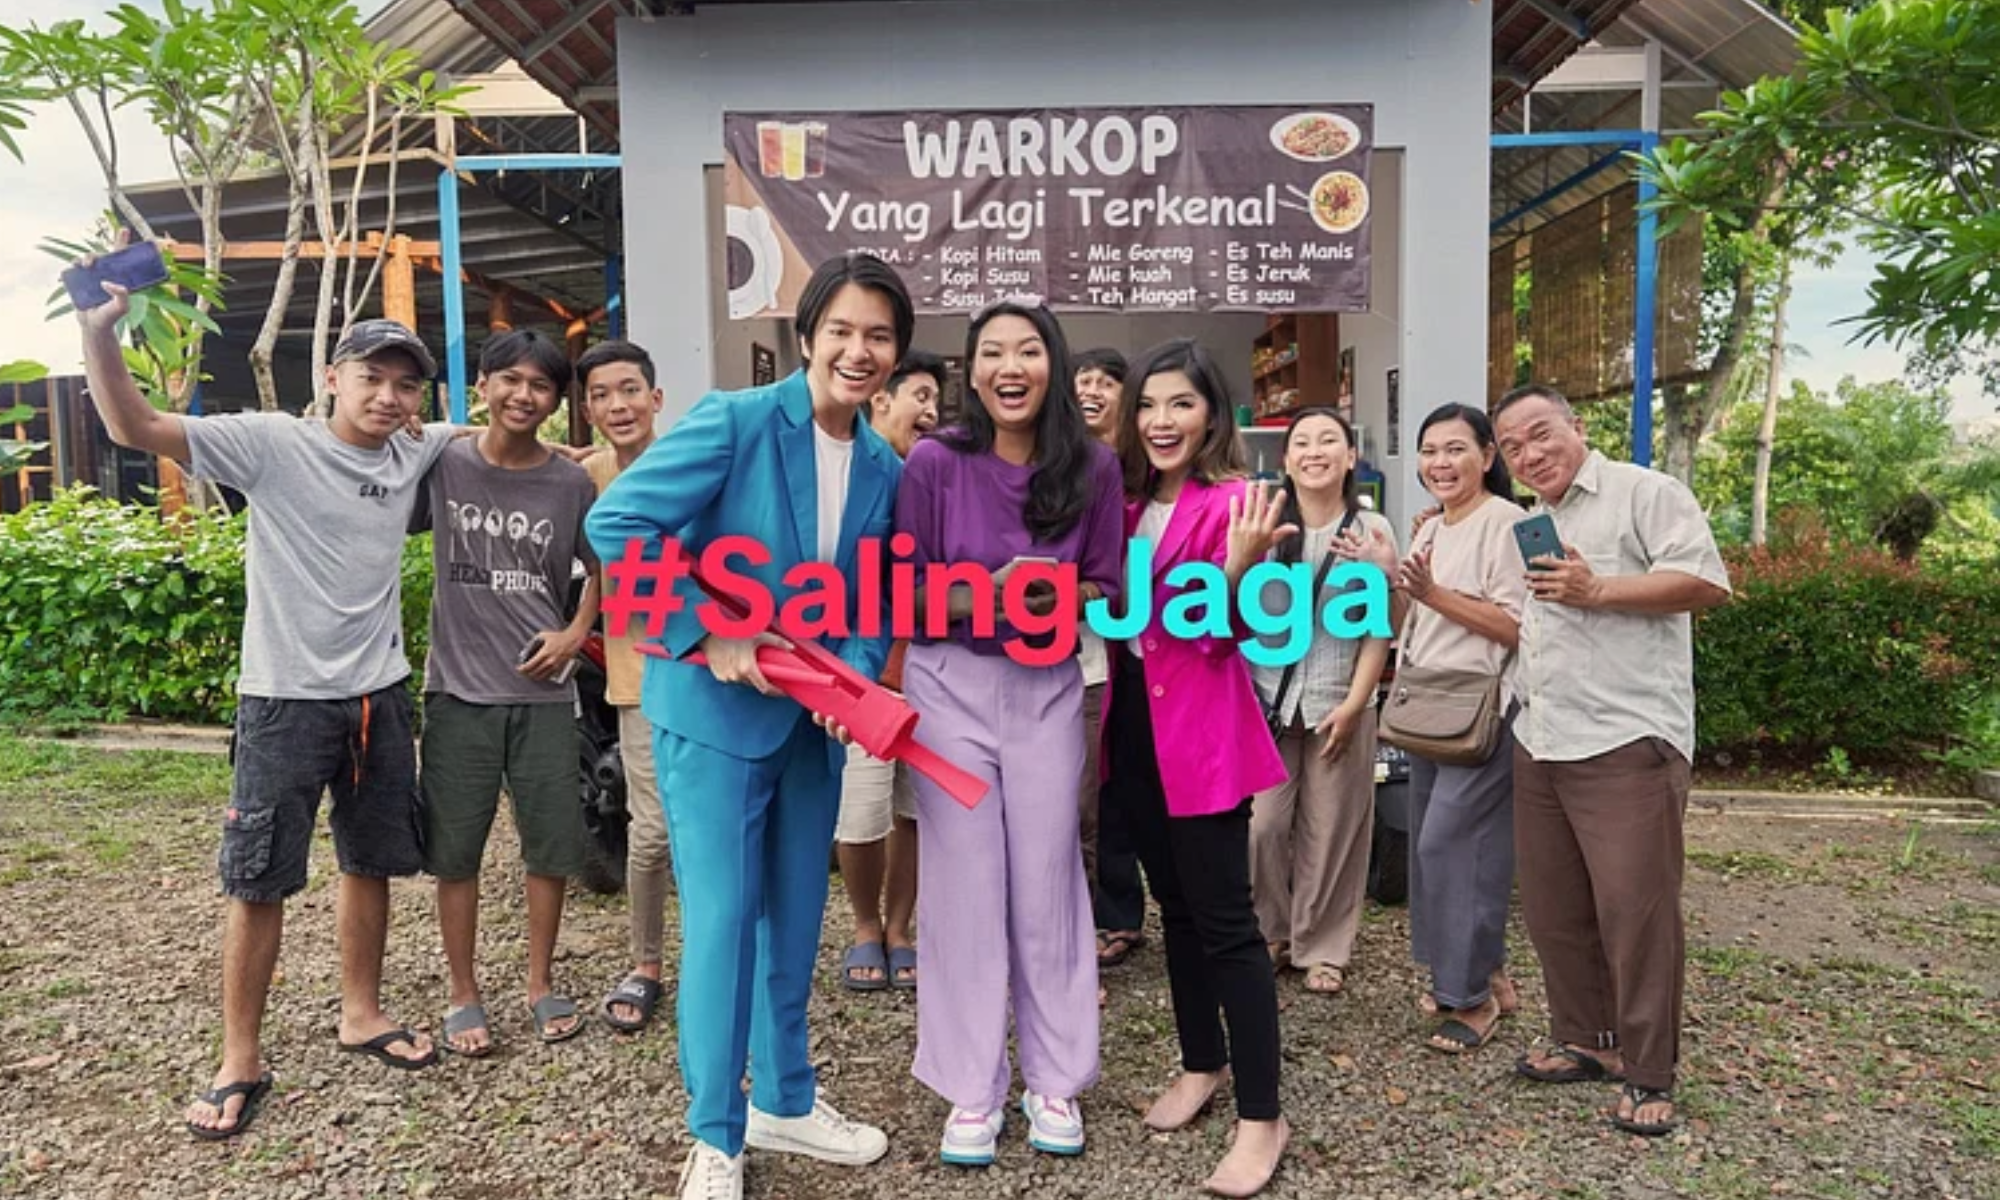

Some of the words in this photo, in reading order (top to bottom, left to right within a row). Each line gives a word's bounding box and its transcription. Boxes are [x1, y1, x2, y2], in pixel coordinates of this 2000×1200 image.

[902, 116, 1178, 179] WARKOP
[816, 190, 931, 243] Yang
[952, 188, 1045, 241] Lagi
[1067, 182, 1277, 228] Terkenal
[940, 245, 979, 267] Kopi
[985, 245, 1042, 263] Hitam
[1087, 244, 1121, 262] Mie
[1128, 243, 1194, 265] Goreng
[1226, 242, 1249, 261] Es
[1256, 243, 1293, 260] Teh
[1299, 242, 1354, 261] Manis
[940, 266, 979, 290] Kopi
[986, 267, 1031, 285] Susu
[1087, 264, 1121, 283] Mie
[1129, 264, 1172, 283] kuah
[1226, 263, 1249, 282] Es
[1256, 263, 1311, 282] Jeruk
[941, 289, 985, 306] Susu
[1088, 286, 1124, 305] Teh
[1130, 286, 1198, 306] Hangat
[1226, 285, 1249, 304] Es
[1256, 289, 1296, 304] susu
